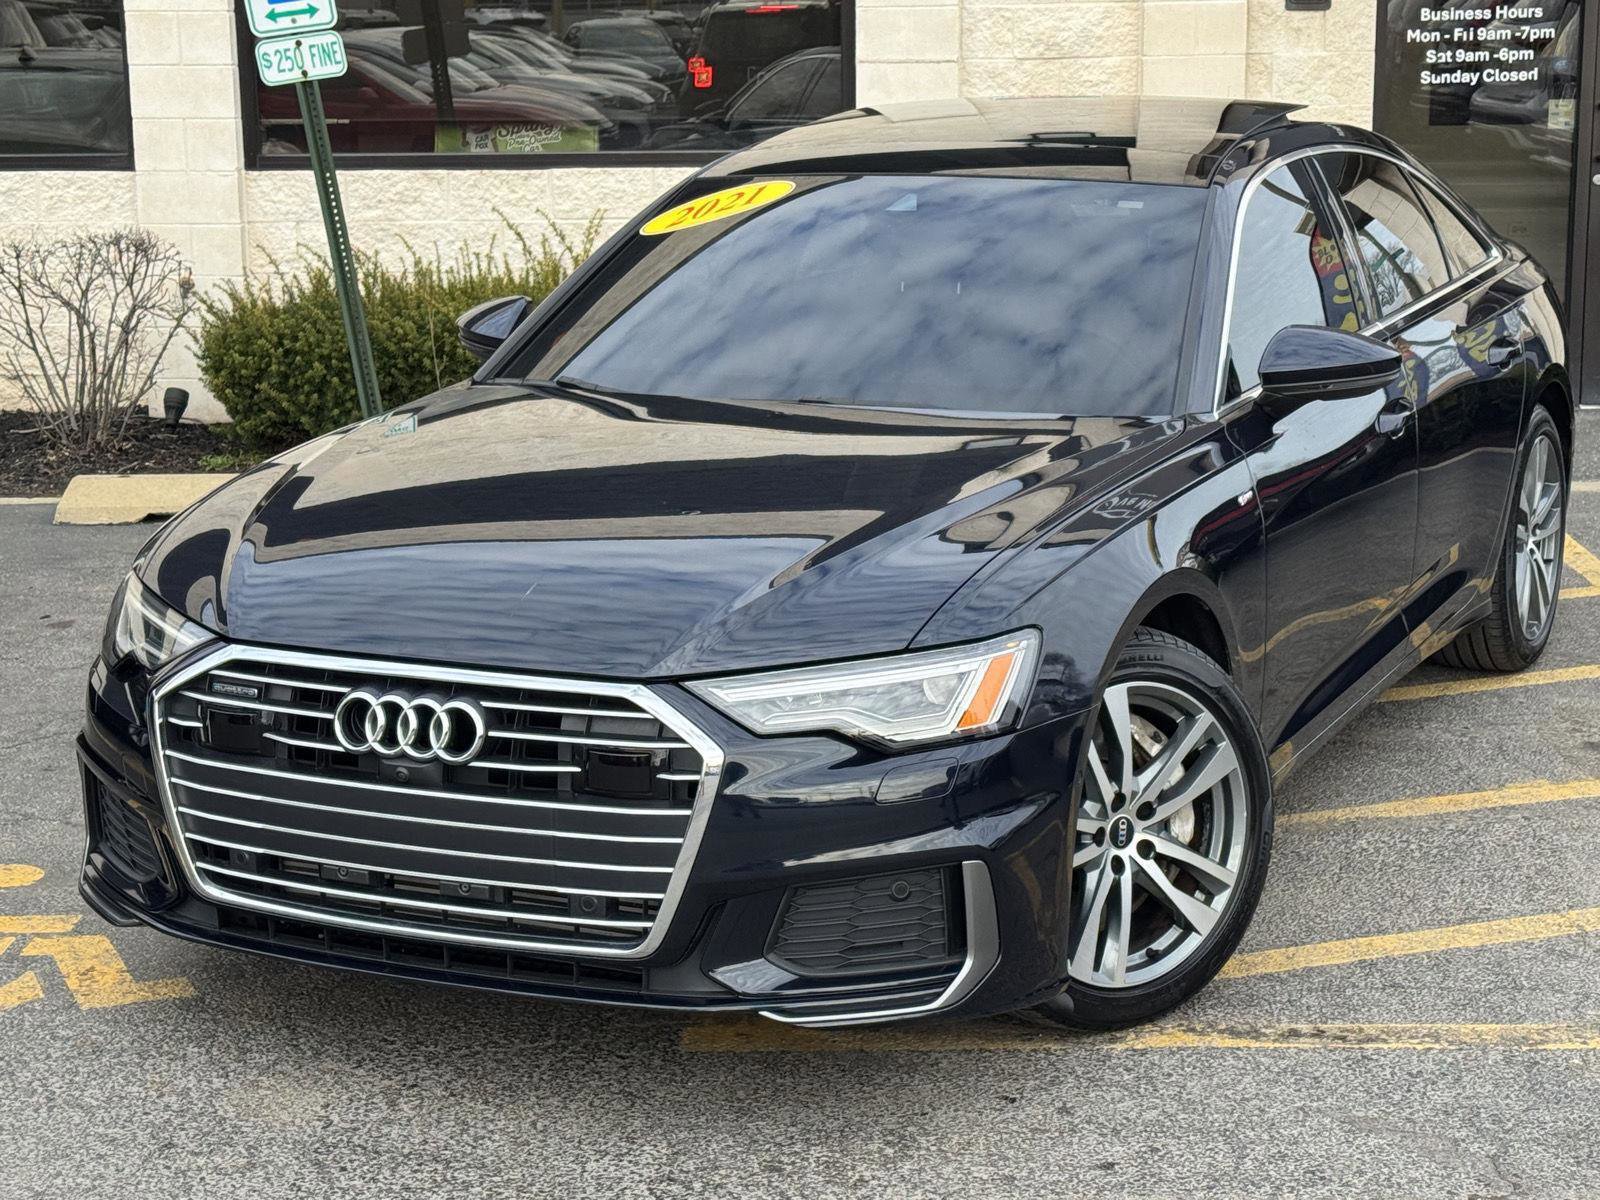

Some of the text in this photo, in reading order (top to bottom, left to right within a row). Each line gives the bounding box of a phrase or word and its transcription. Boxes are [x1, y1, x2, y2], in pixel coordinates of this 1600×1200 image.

[1420, 5, 1543, 22] Business Hours
[1406, 28, 1440, 43] Mon
[1477, 27, 1512, 41] 9am
[262, 41, 342, 74] $250 FINE
[1426, 49, 1452, 63] Sat
[1455, 49, 1489, 62] 9am
[1420, 67, 1539, 86] Sunday Closed
[664, 185, 768, 229] 2021
